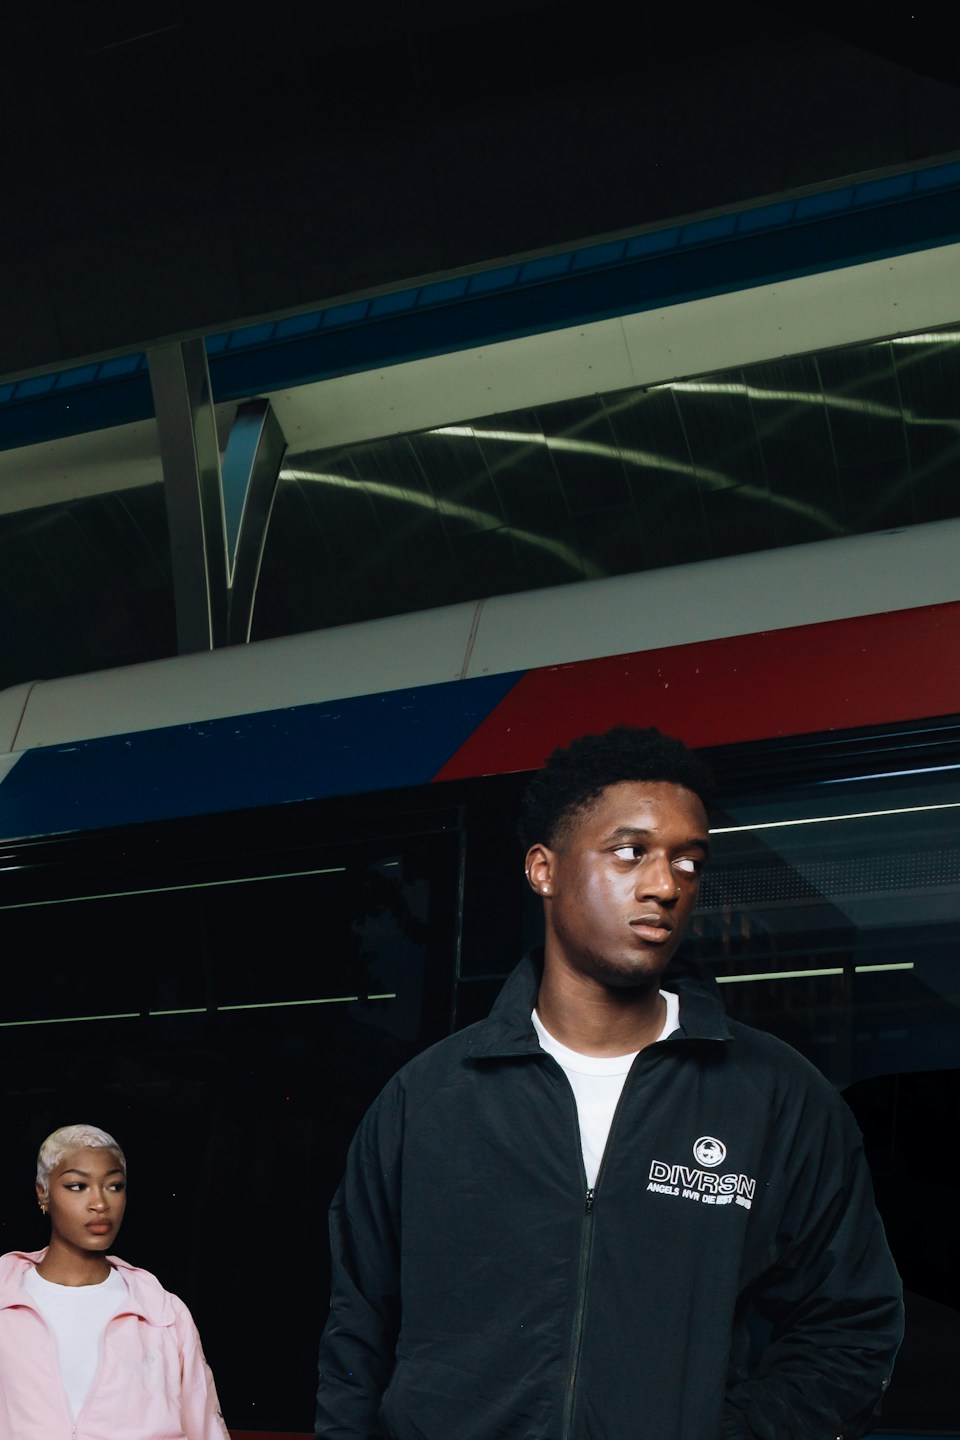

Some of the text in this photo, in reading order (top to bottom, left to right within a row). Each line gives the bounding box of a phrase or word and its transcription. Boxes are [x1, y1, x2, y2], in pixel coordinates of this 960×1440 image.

[646, 1182, 680, 1197] ANGELS
[682, 1189, 700, 1201] NVR
[648, 1160, 757, 1200] DIVRSN
